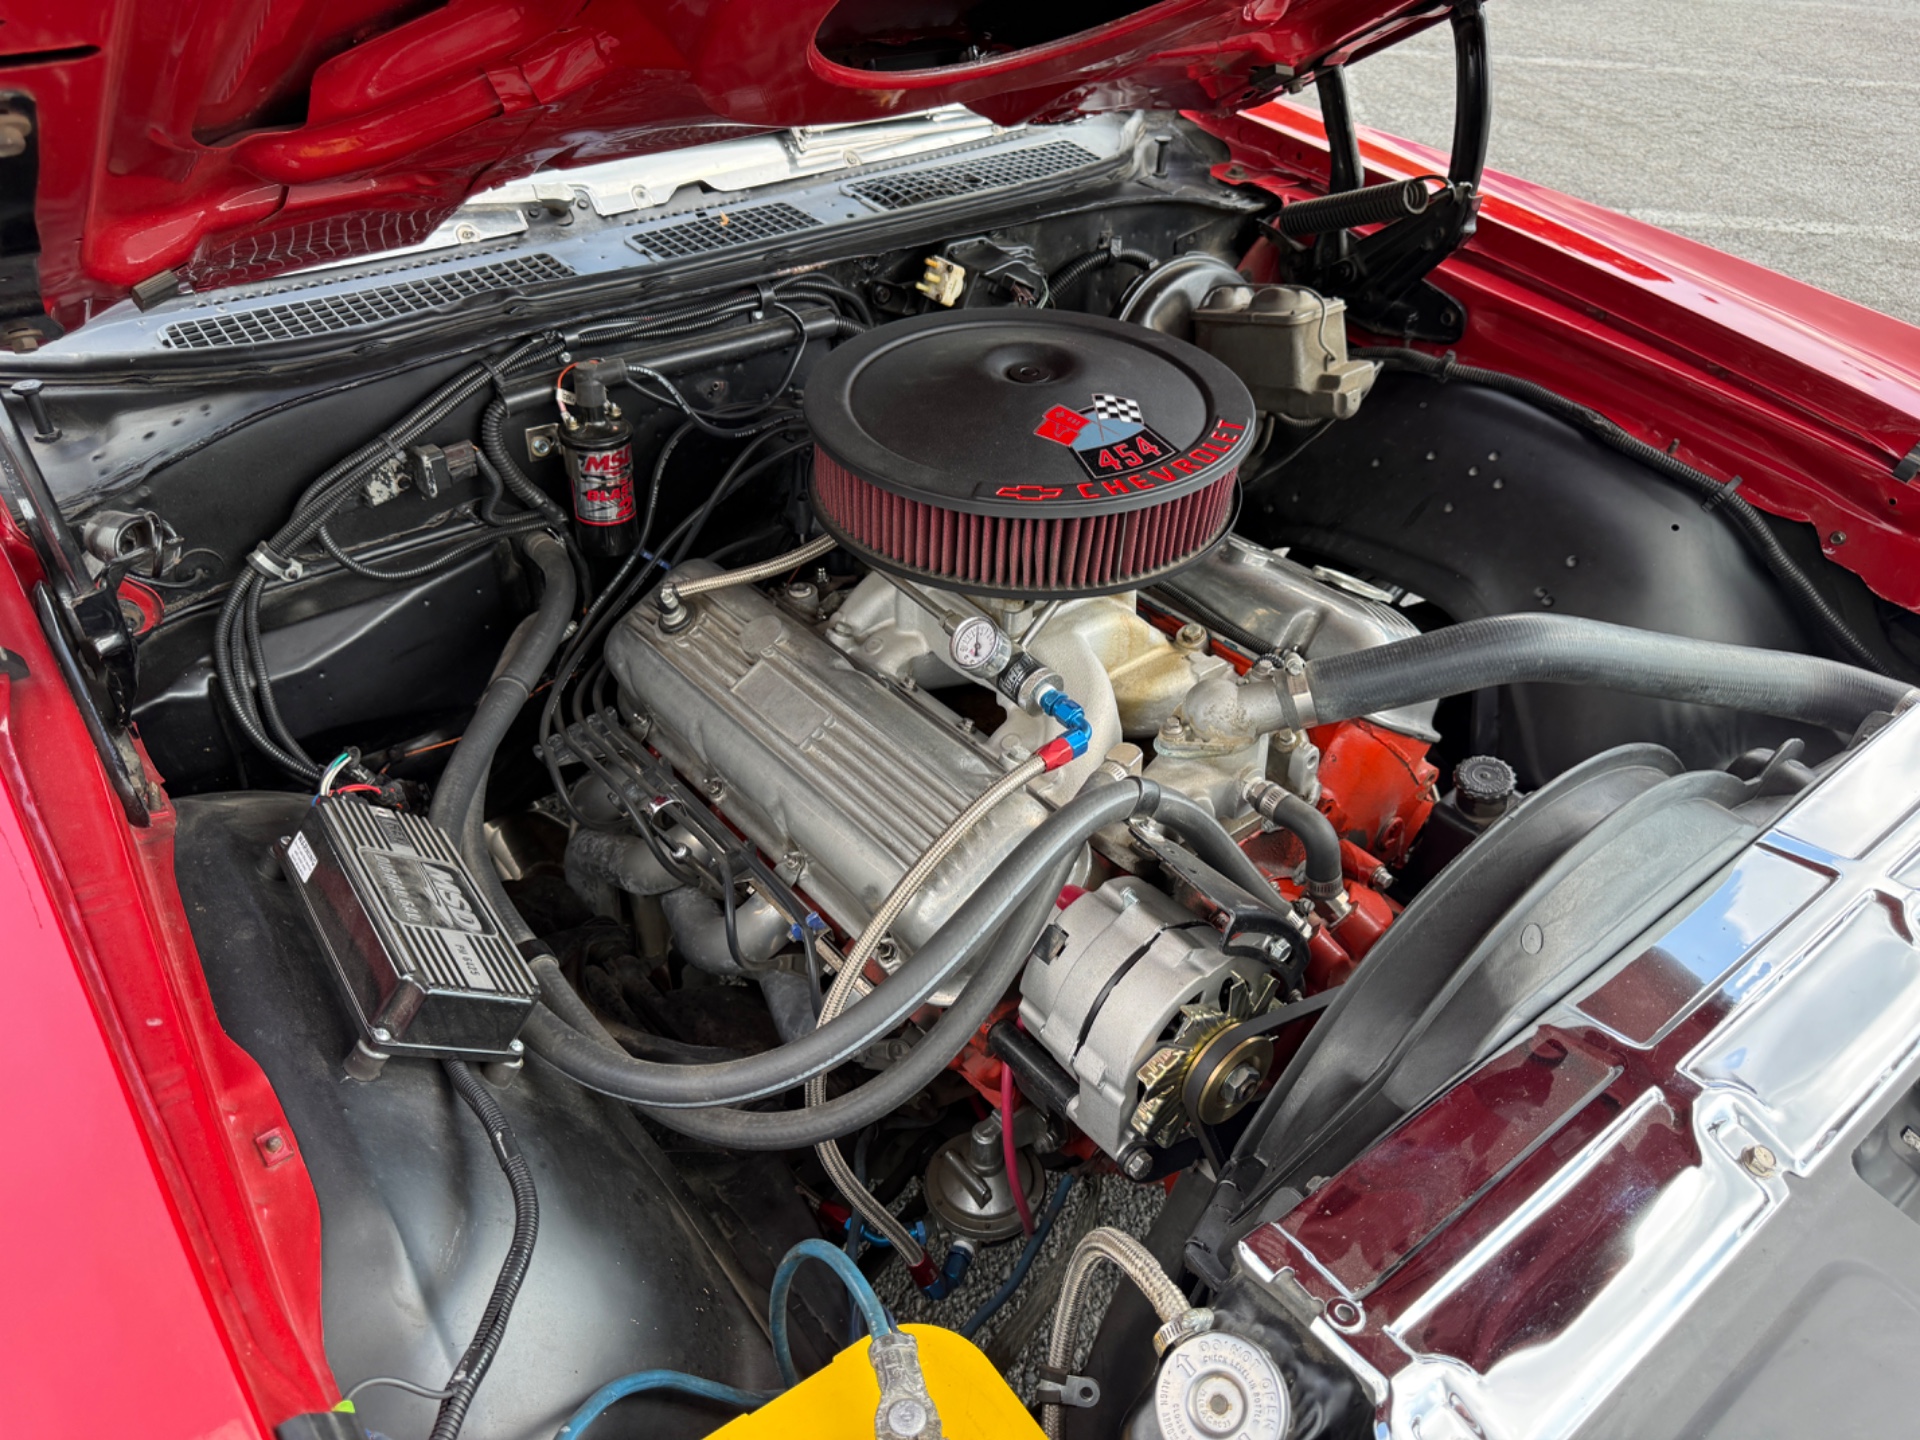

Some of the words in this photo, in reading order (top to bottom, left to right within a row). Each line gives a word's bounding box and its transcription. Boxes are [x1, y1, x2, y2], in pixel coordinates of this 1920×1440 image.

[1077, 419, 1246, 499] CHEVROLET
[1099, 436, 1161, 470] 454
[616, 495, 633, 518] 2
[422, 862, 482, 932] MSD
[1160, 1379, 1171, 1406] ALIGN
[1199, 1339, 1223, 1352] DO
[1230, 1343, 1262, 1370] NOT
[1261, 1378, 1278, 1431] OPEN
[1202, 1354, 1228, 1365] CHECK
[1229, 1359, 1250, 1381] LEVEL
[1252, 1391, 1263, 1425] BOTTLE
